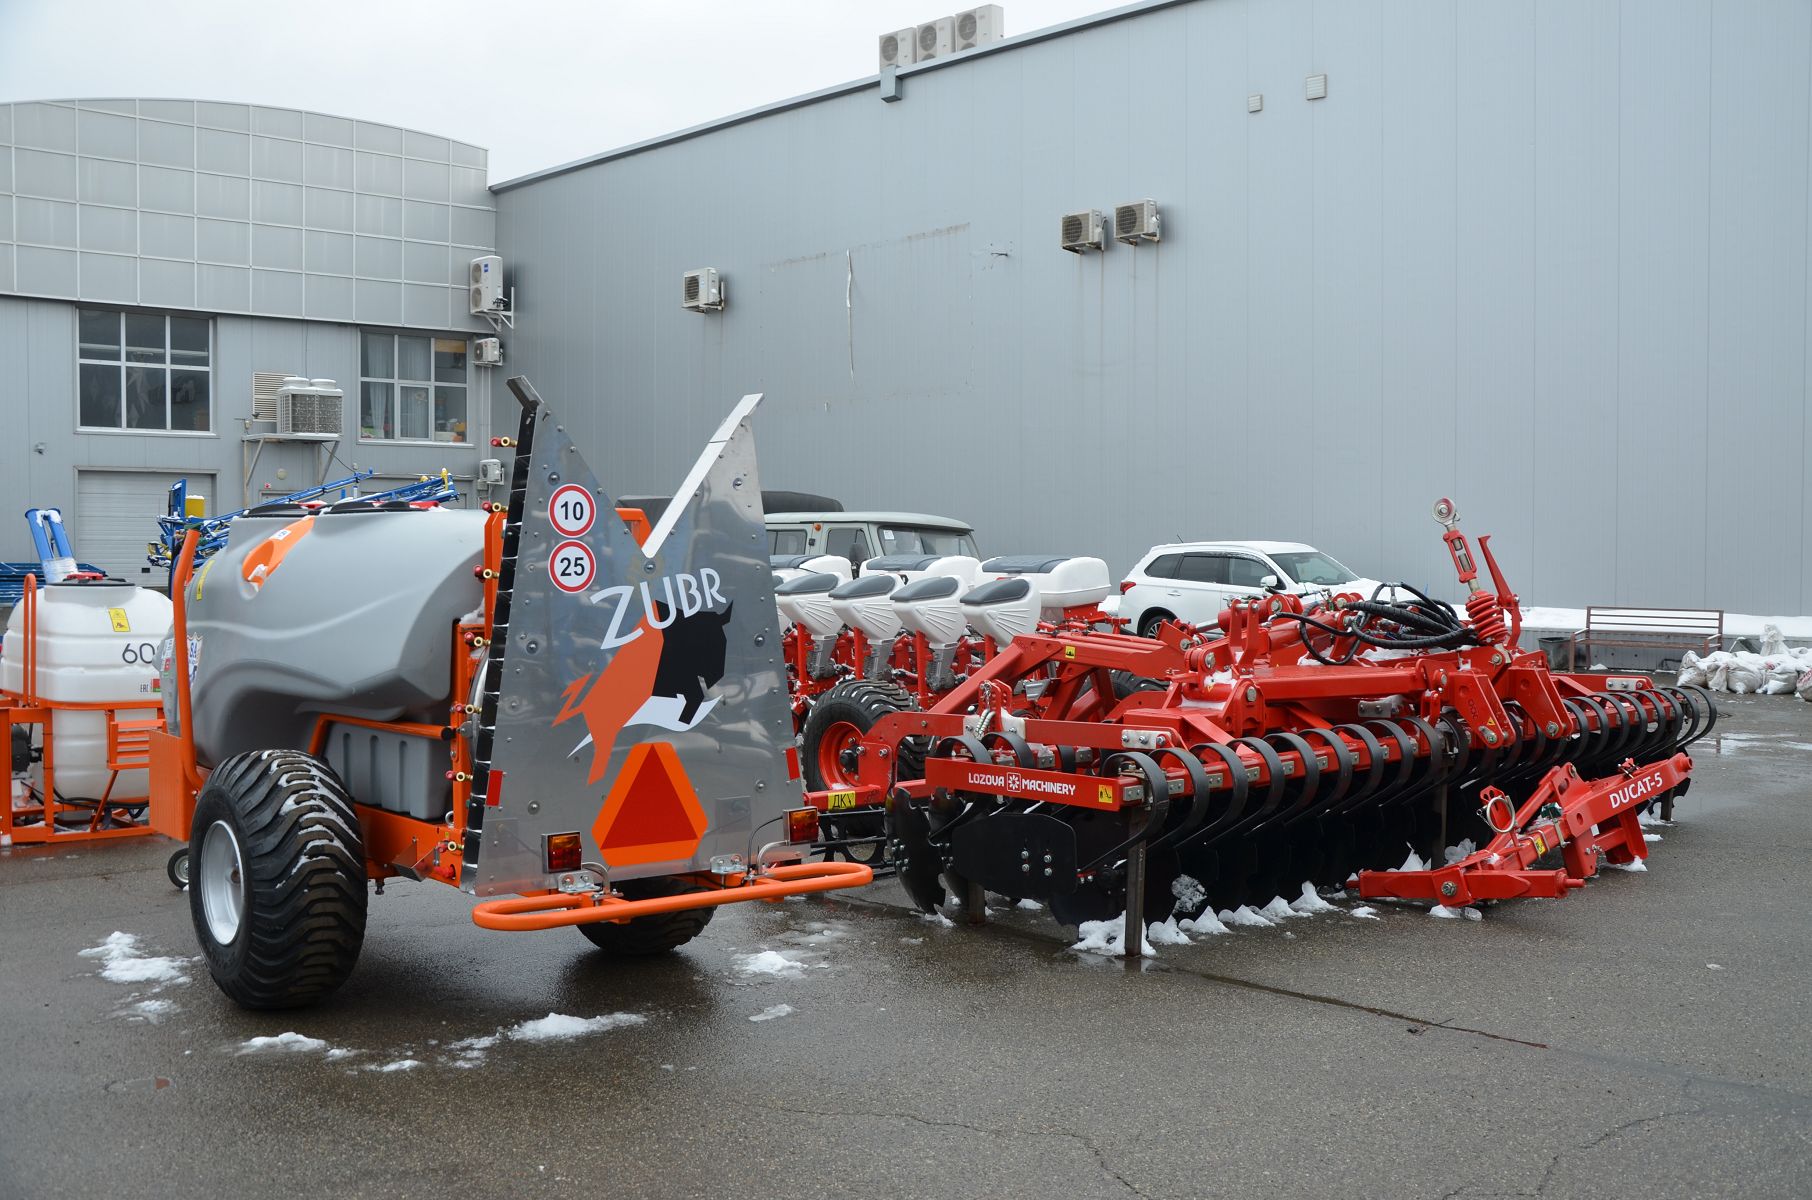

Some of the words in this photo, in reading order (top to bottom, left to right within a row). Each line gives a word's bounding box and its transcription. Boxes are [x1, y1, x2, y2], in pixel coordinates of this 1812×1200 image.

[561, 501, 584, 521] 10
[560, 557, 585, 577] 25
[590, 567, 727, 650] ZUBR
[122, 642, 160, 664] 60
[968, 772, 1005, 787] LOZOVA
[1021, 778, 1076, 796] MACHINERY
[1609, 771, 1663, 809] DUCAT-5
